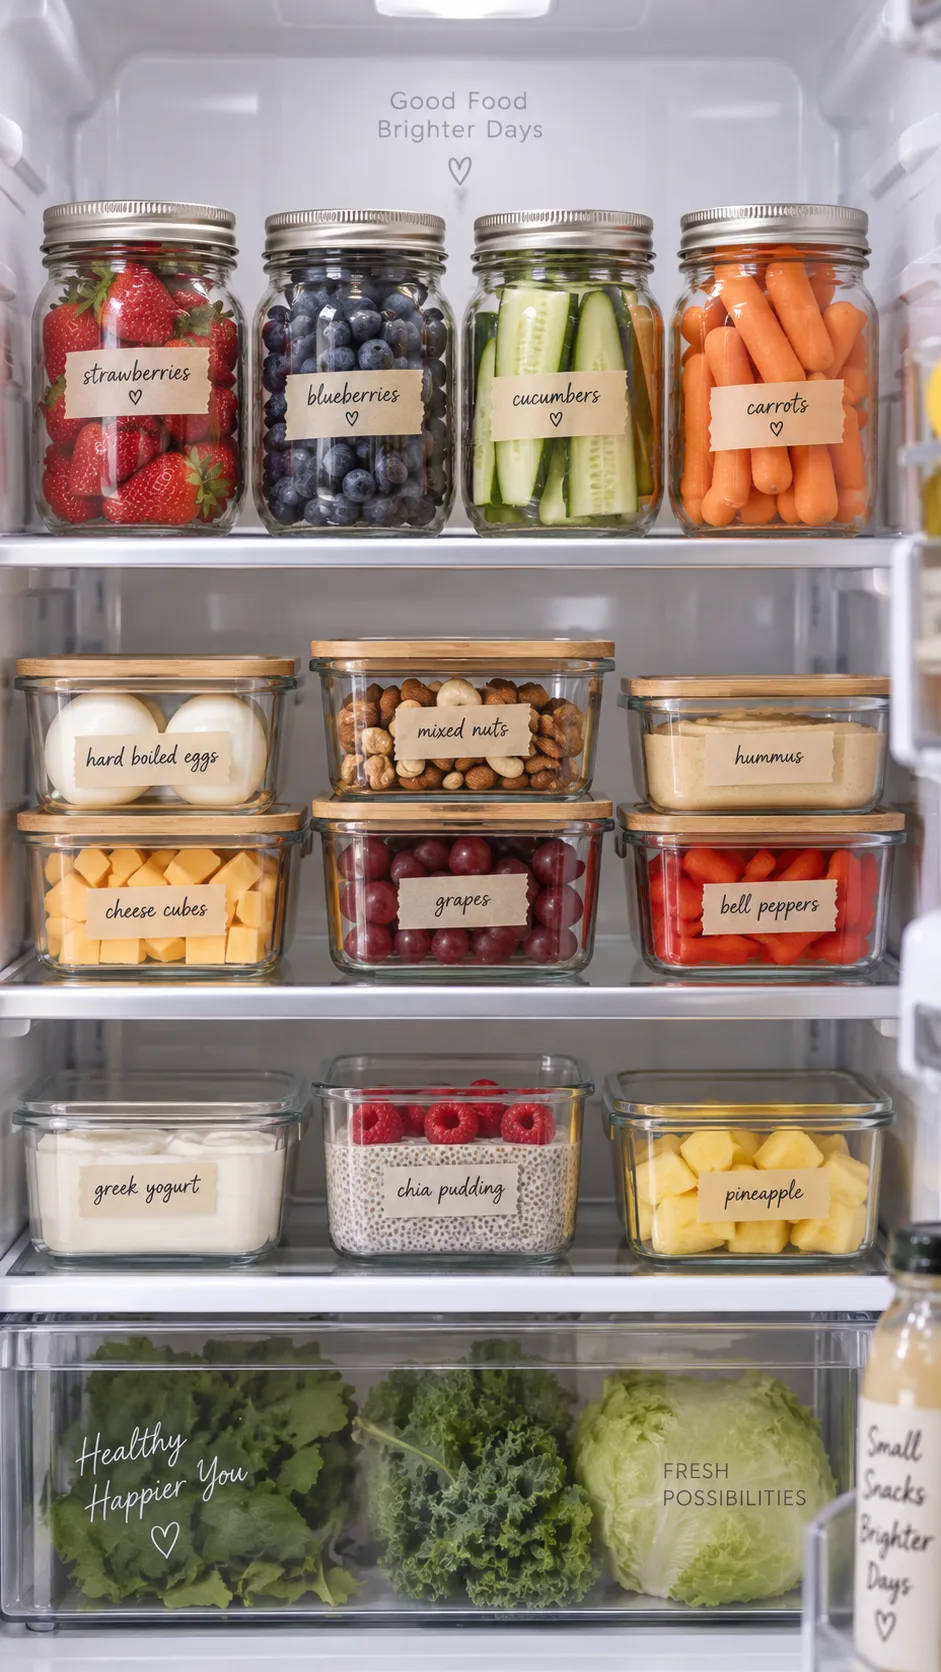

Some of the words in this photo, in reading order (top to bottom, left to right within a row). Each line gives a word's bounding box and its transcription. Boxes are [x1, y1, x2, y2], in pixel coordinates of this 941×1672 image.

[390, 92, 454, 109] Good
[469, 92, 526, 110] Food
[379, 119, 475, 142] Brighter
[488, 120, 542, 143] Days
[83, 359, 192, 385] strawberries
[308, 382, 400, 405] blueberries
[513, 382, 601, 406] cucumbers
[747, 391, 809, 415] carrots
[417, 716, 466, 739] mixed
[472, 717, 508, 737] nuts
[86, 746, 125, 767] hard
[132, 745, 178, 766] boiled
[184, 750, 219, 772] eggs
[735, 745, 804, 765] hummus
[106, 898, 155, 919] cheese
[162, 896, 208, 916] cubes
[435, 894, 492, 917] grapes
[721, 894, 752, 914] bell
[757, 900, 819, 921] peppers
[94, 1175, 139, 1205] greek
[146, 1174, 202, 1205] yogurt
[398, 1178, 432, 1197] chia
[438, 1176, 505, 1204] pudding
[725, 1179, 805, 1211] pineapple
[75, 1422, 187, 1476] Healthy
[867, 1424, 922, 1463] Small
[664, 1463, 728, 1479] FRESH
[83, 1476, 187, 1524] Happier
[196, 1456, 248, 1502] You
[664, 1490, 806, 1506] POSSIBILITIES
[865, 1469, 925, 1506] Snacks
[861, 1513, 933, 1560] Brighter
[868, 1561, 911, 1605] Days
